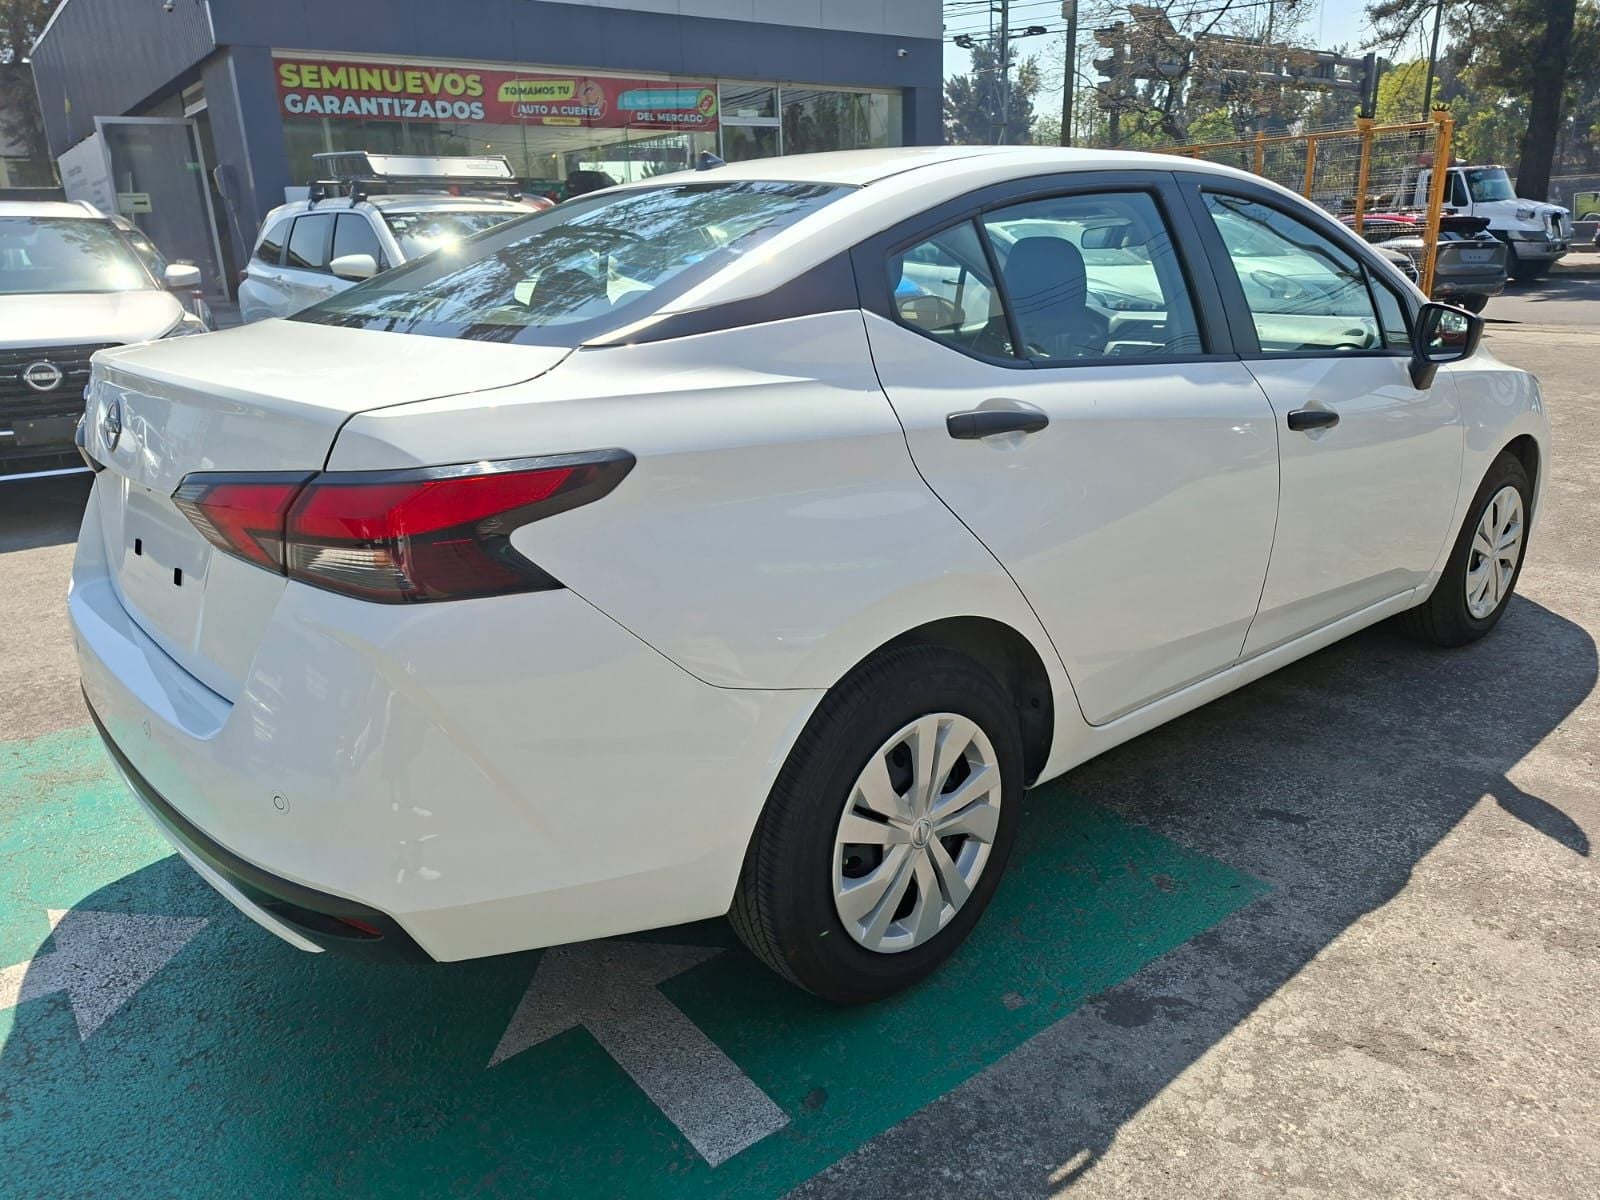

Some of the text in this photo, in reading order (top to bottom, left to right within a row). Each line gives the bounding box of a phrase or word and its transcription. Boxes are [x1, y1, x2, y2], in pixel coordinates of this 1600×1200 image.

[279, 63, 484, 97] SEMINUEVOS
[503, 86, 570, 96] TOMAMOS TU
[284, 93, 485, 120] GARANTIZADOS
[517, 104, 601, 117] AUTO A CUENTA
[637, 112, 704, 123] DEL MERCADO
